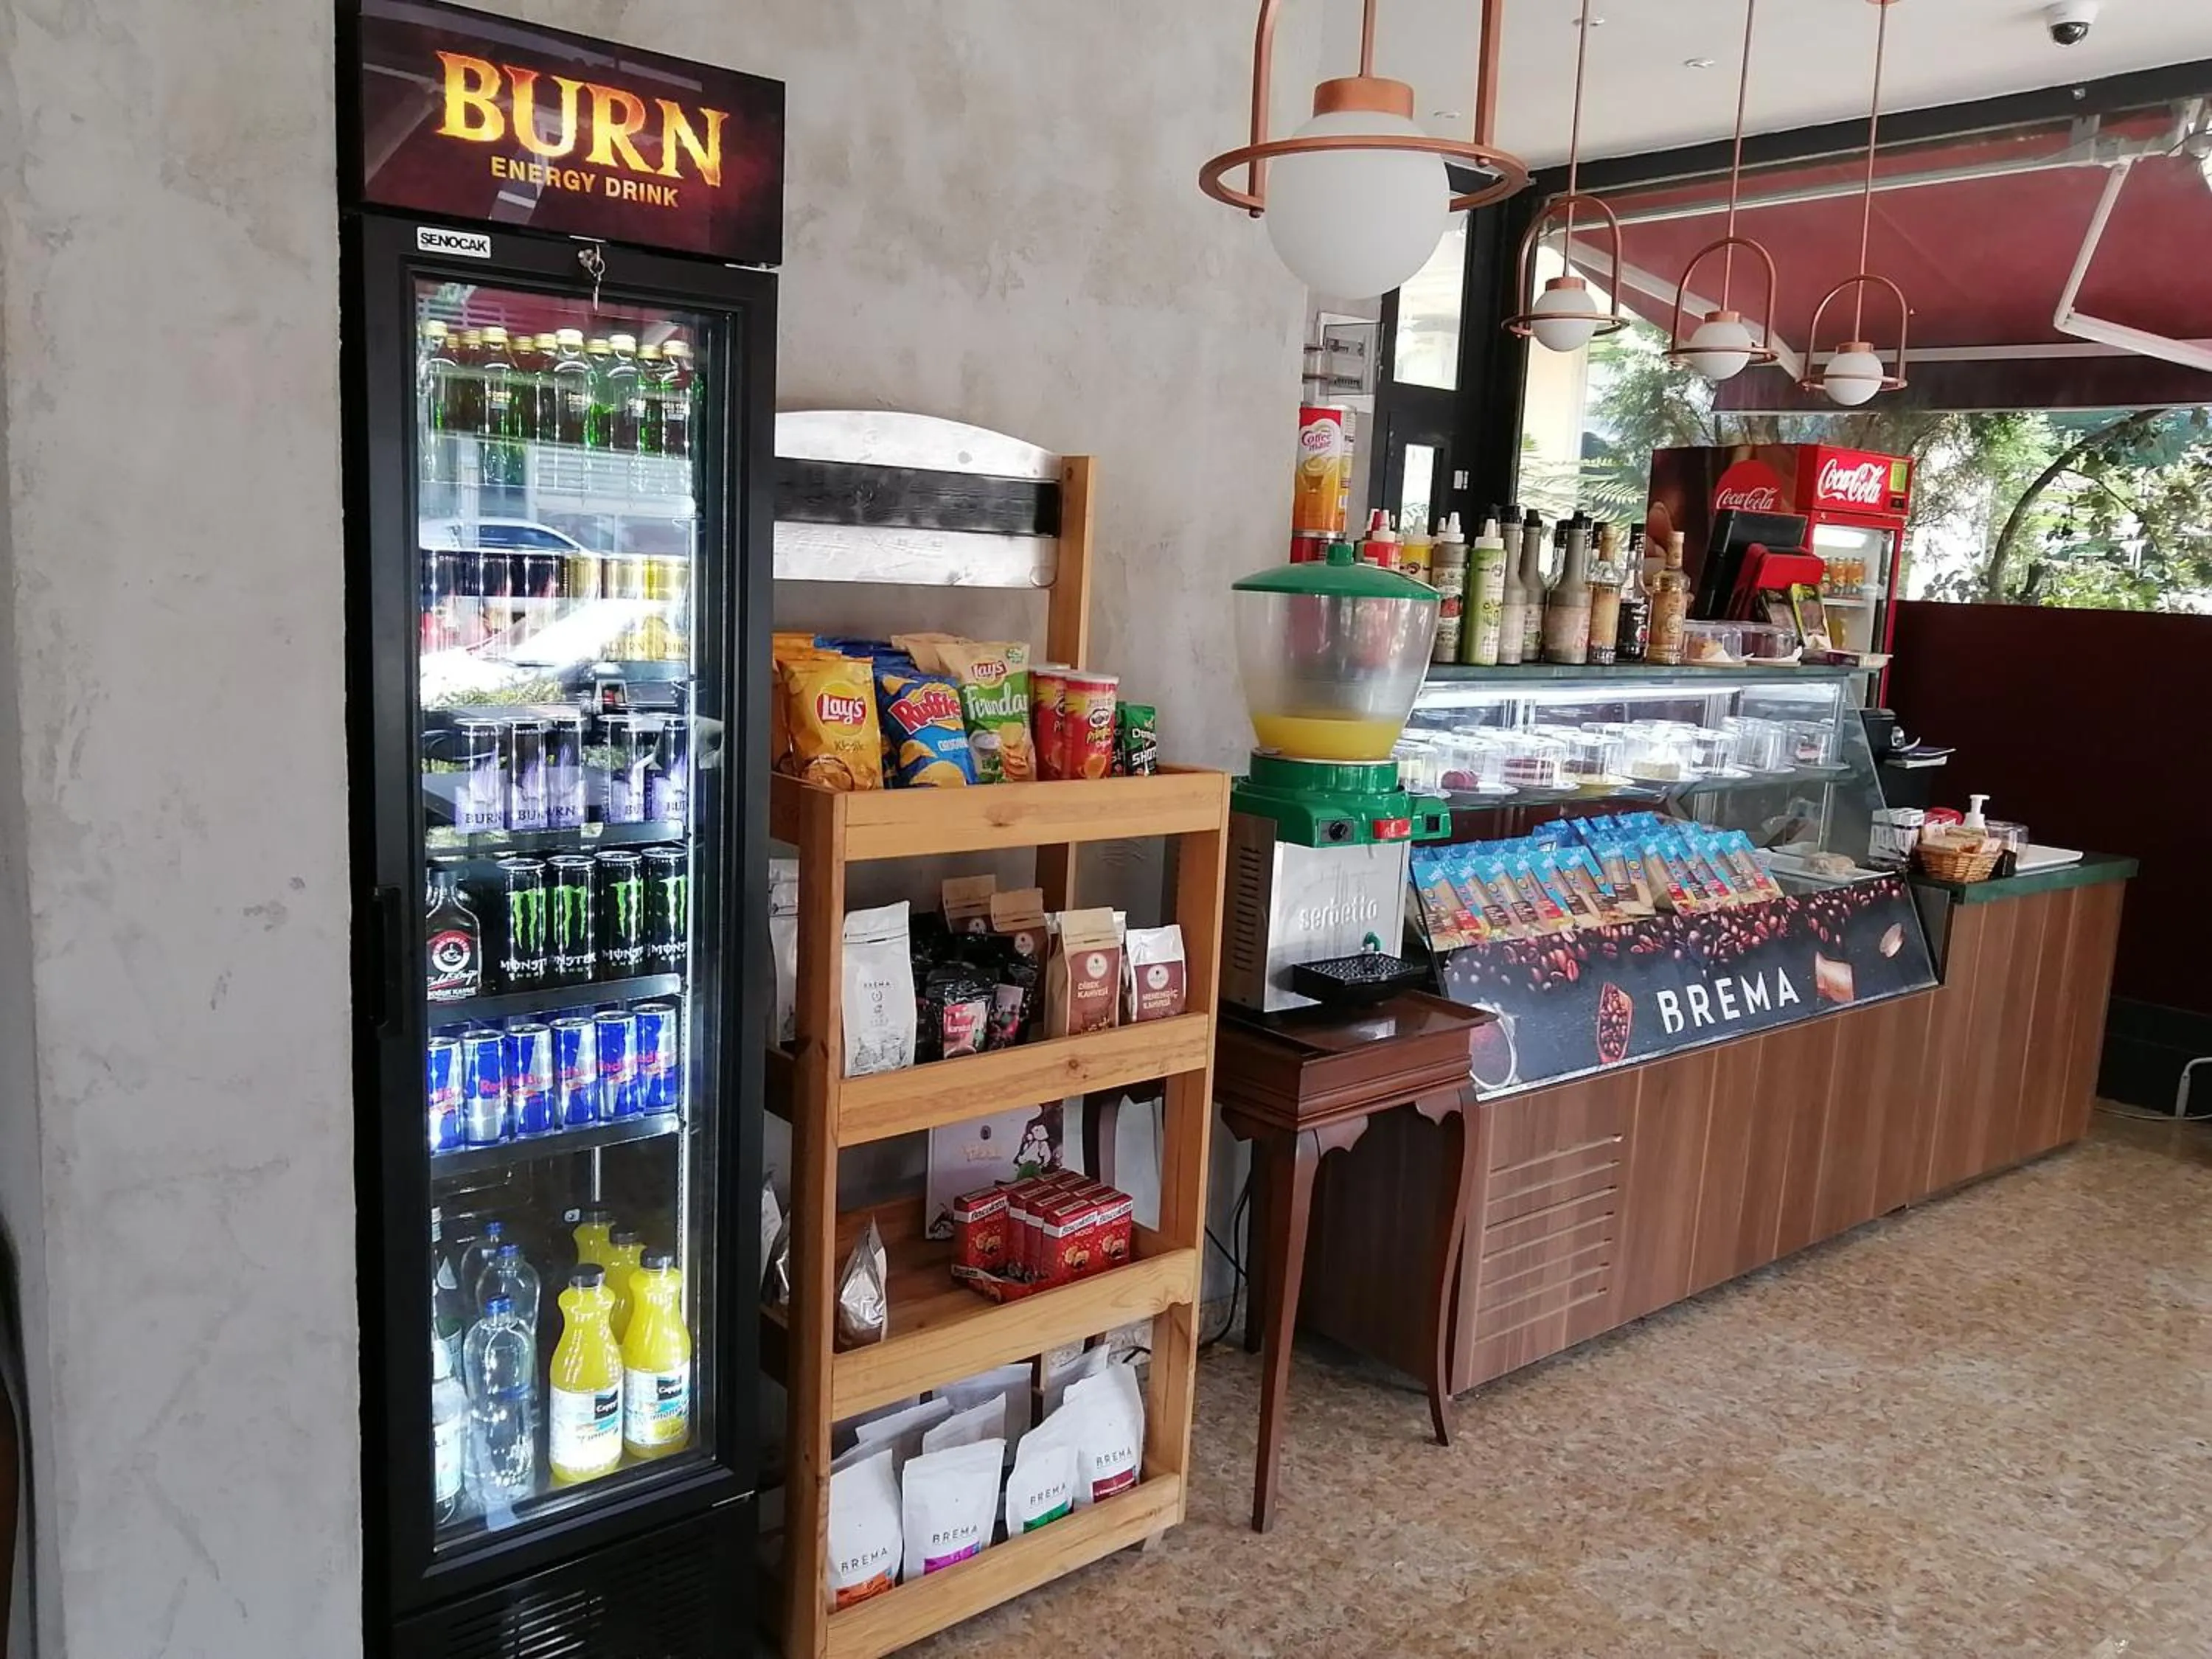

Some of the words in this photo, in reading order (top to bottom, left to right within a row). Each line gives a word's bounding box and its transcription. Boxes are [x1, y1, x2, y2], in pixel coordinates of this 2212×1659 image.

[435, 50, 728, 187] BURN
[491, 156, 594, 193] ENERGY
[605, 175, 680, 208] DRINK
[420, 232, 487, 253] SENOCAK
[1816, 457, 1889, 504] Coca-Cola
[1716, 487, 1781, 510] Coca-Cola
[1298, 897, 1378, 931] serbetto
[1657, 967, 1801, 1034] BREMA
[1096, 1446, 1133, 1467] BREMA
[1030, 1482, 1066, 1506] BREMA
[932, 1523, 979, 1545] BREMA
[841, 1547, 888, 1573] BREMA
